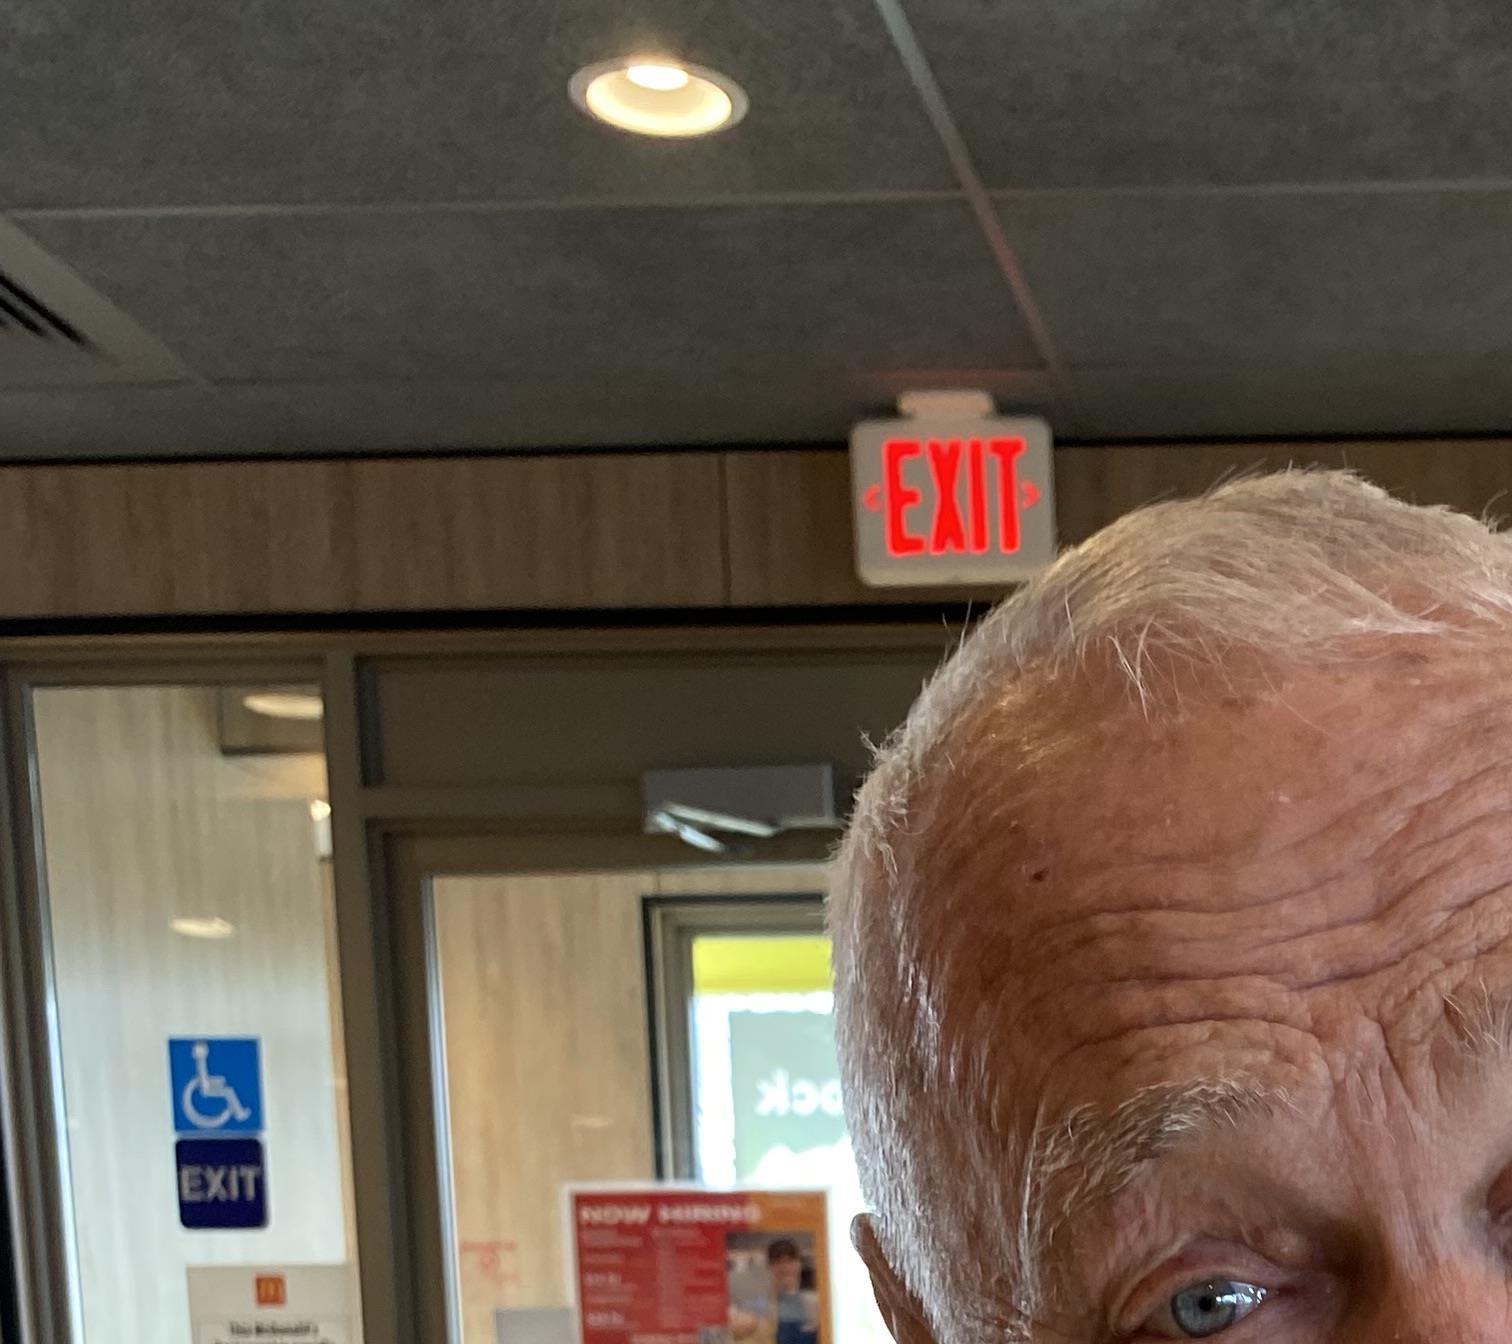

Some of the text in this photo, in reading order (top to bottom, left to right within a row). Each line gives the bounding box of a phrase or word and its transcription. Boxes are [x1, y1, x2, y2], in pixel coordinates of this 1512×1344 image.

[883, 437, 1027, 558] EXIT
[181, 1164, 261, 1202] EXIT
[581, 1203, 762, 1225] NOW HIRING
